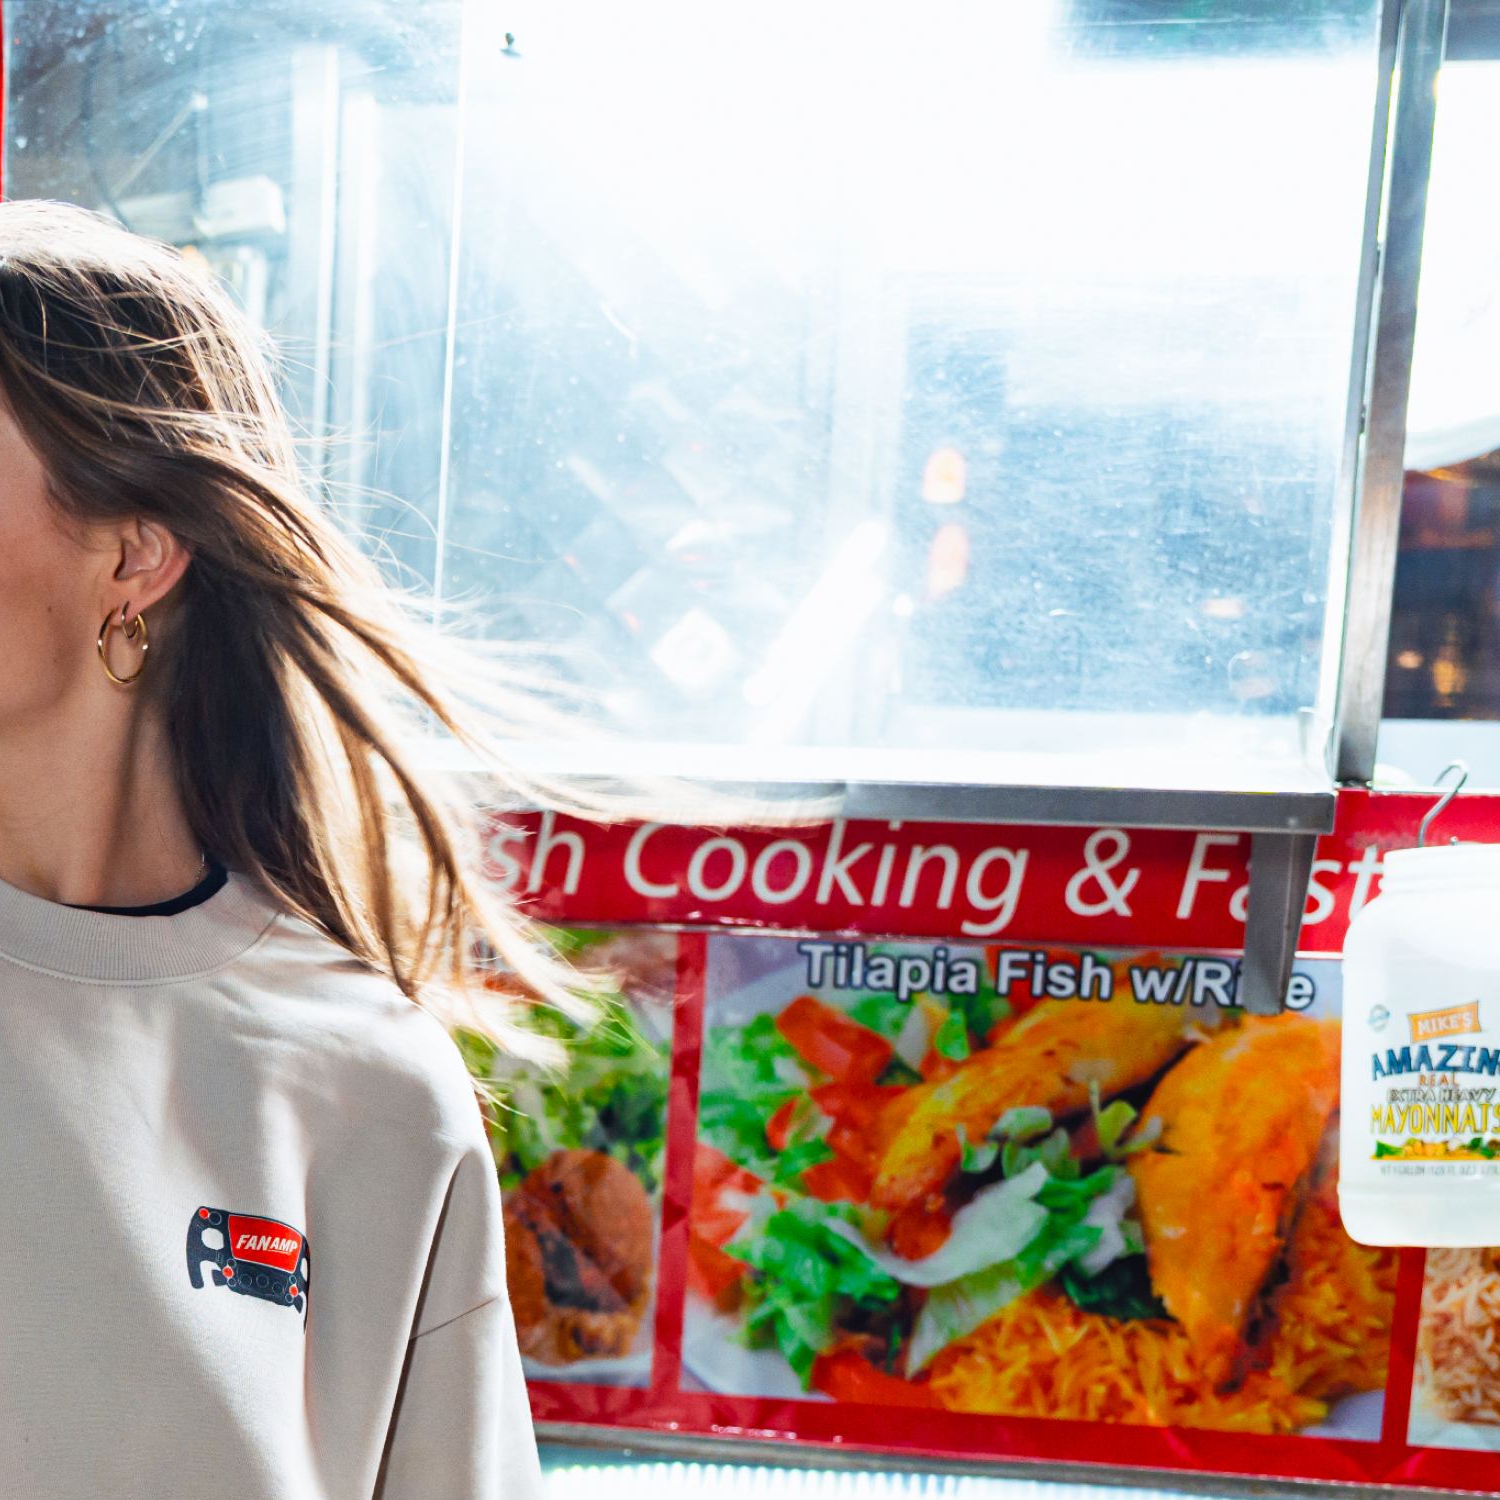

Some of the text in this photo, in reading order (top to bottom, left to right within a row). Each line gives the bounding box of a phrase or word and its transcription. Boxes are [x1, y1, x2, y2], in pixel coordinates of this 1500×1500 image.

[623, 817, 1030, 936] Cooking
[1175, 832, 1384, 926] Fst
[801, 942, 979, 1000] Tilapia
[996, 951, 1113, 1003] Fish
[1417, 1010, 1473, 1036] MIKE'S
[1372, 1044, 1500, 1082] AMAZIN
[1418, 1072, 1460, 1087] REAL
[1387, 1087, 1497, 1102] EXTRA HEAVY
[235, 1233, 298, 1253] FANAMP
